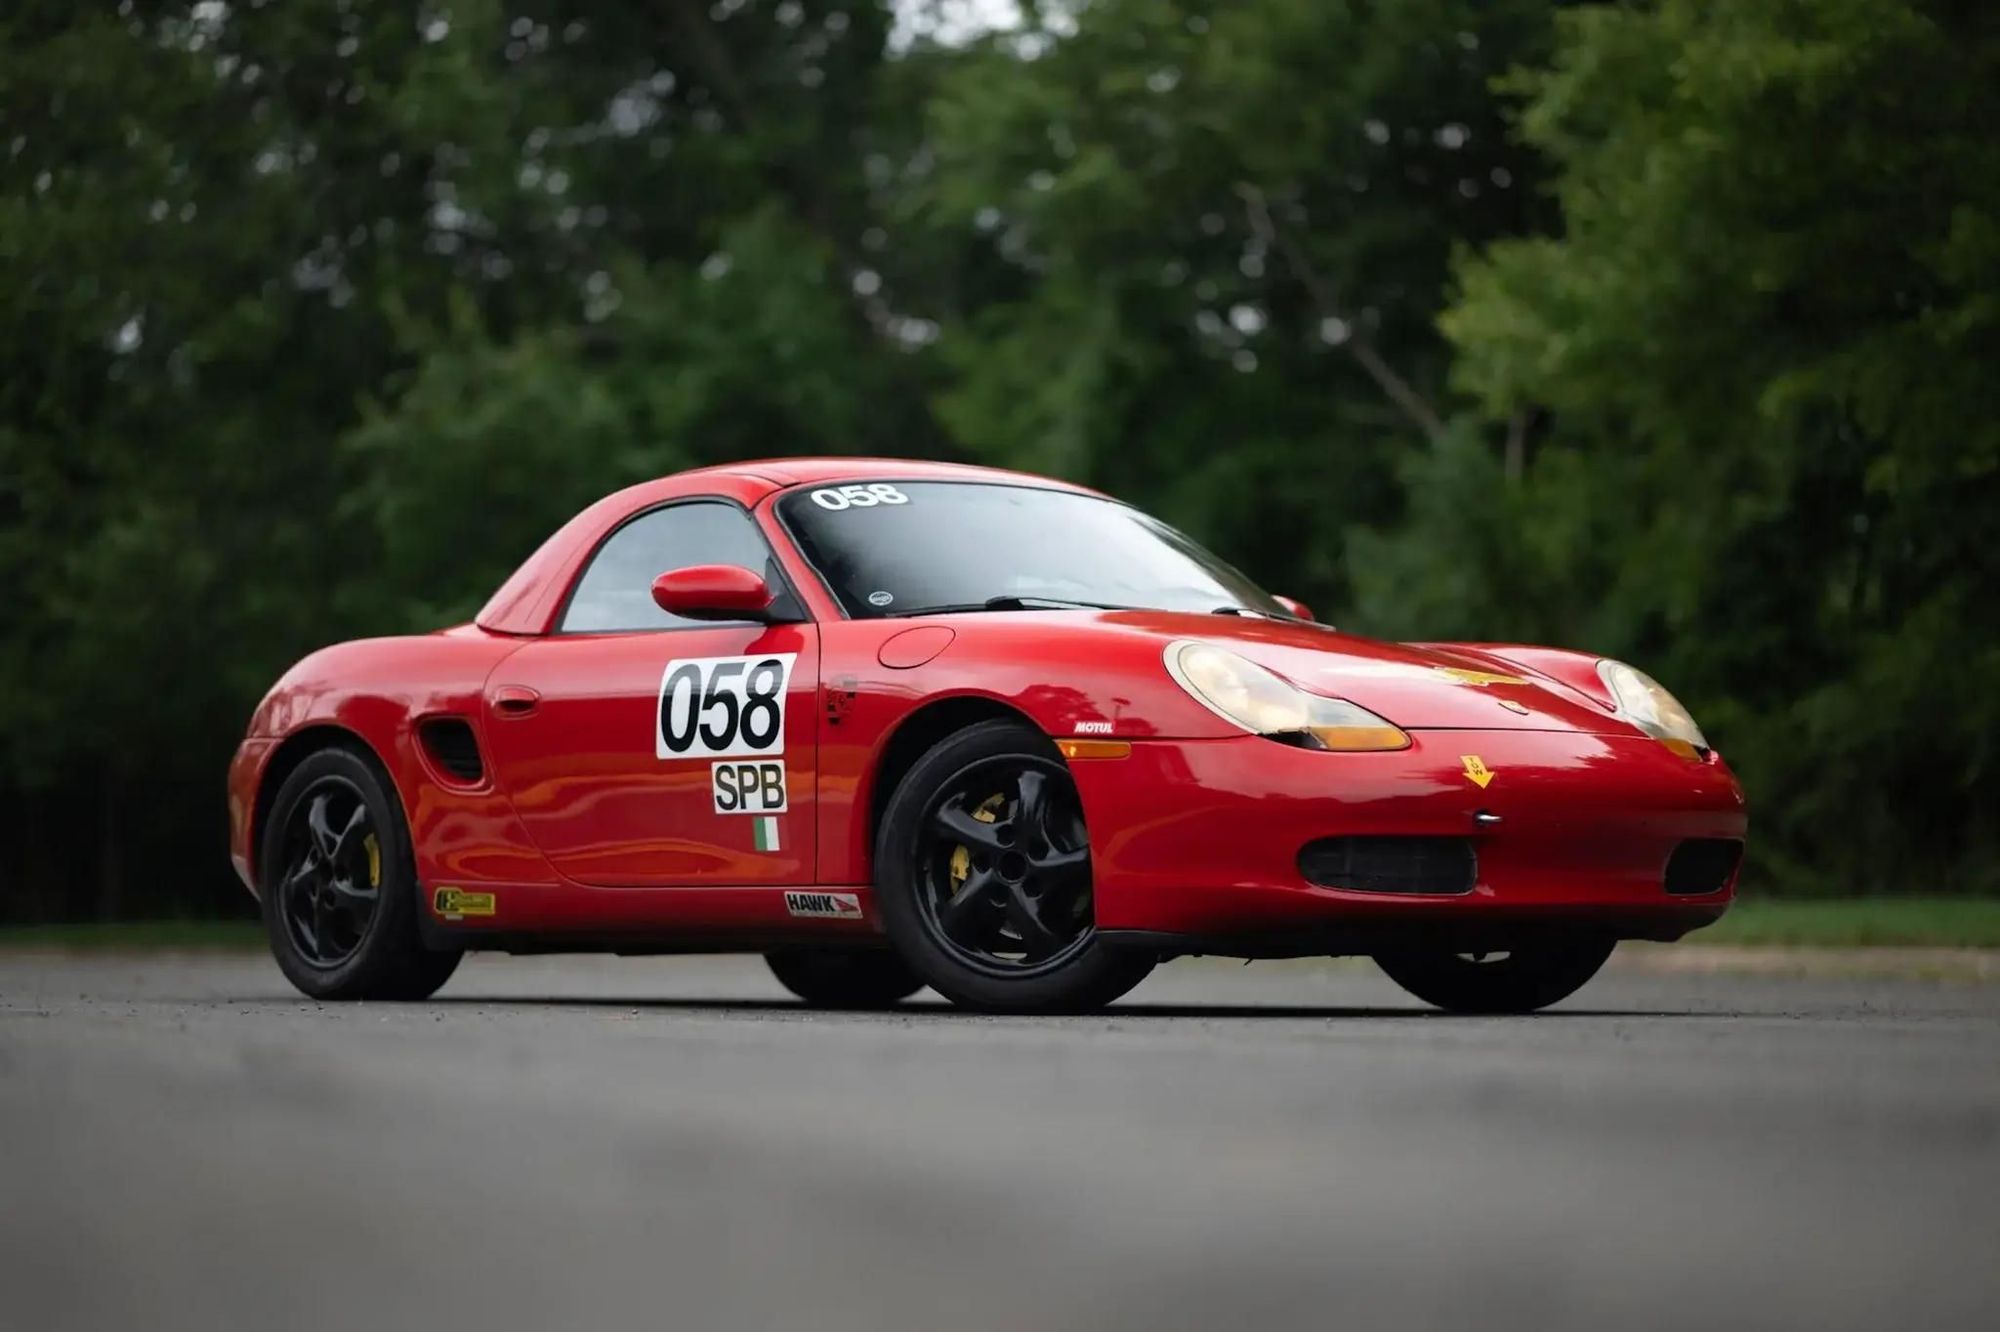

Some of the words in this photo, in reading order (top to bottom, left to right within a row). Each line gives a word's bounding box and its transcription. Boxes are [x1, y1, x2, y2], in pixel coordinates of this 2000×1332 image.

[810, 483, 909, 510] 058
[661, 659, 784, 752] 058
[1074, 722, 1113, 733] MOTUL
[715, 764, 785, 811] SPB
[787, 893, 835, 912] HAWK
